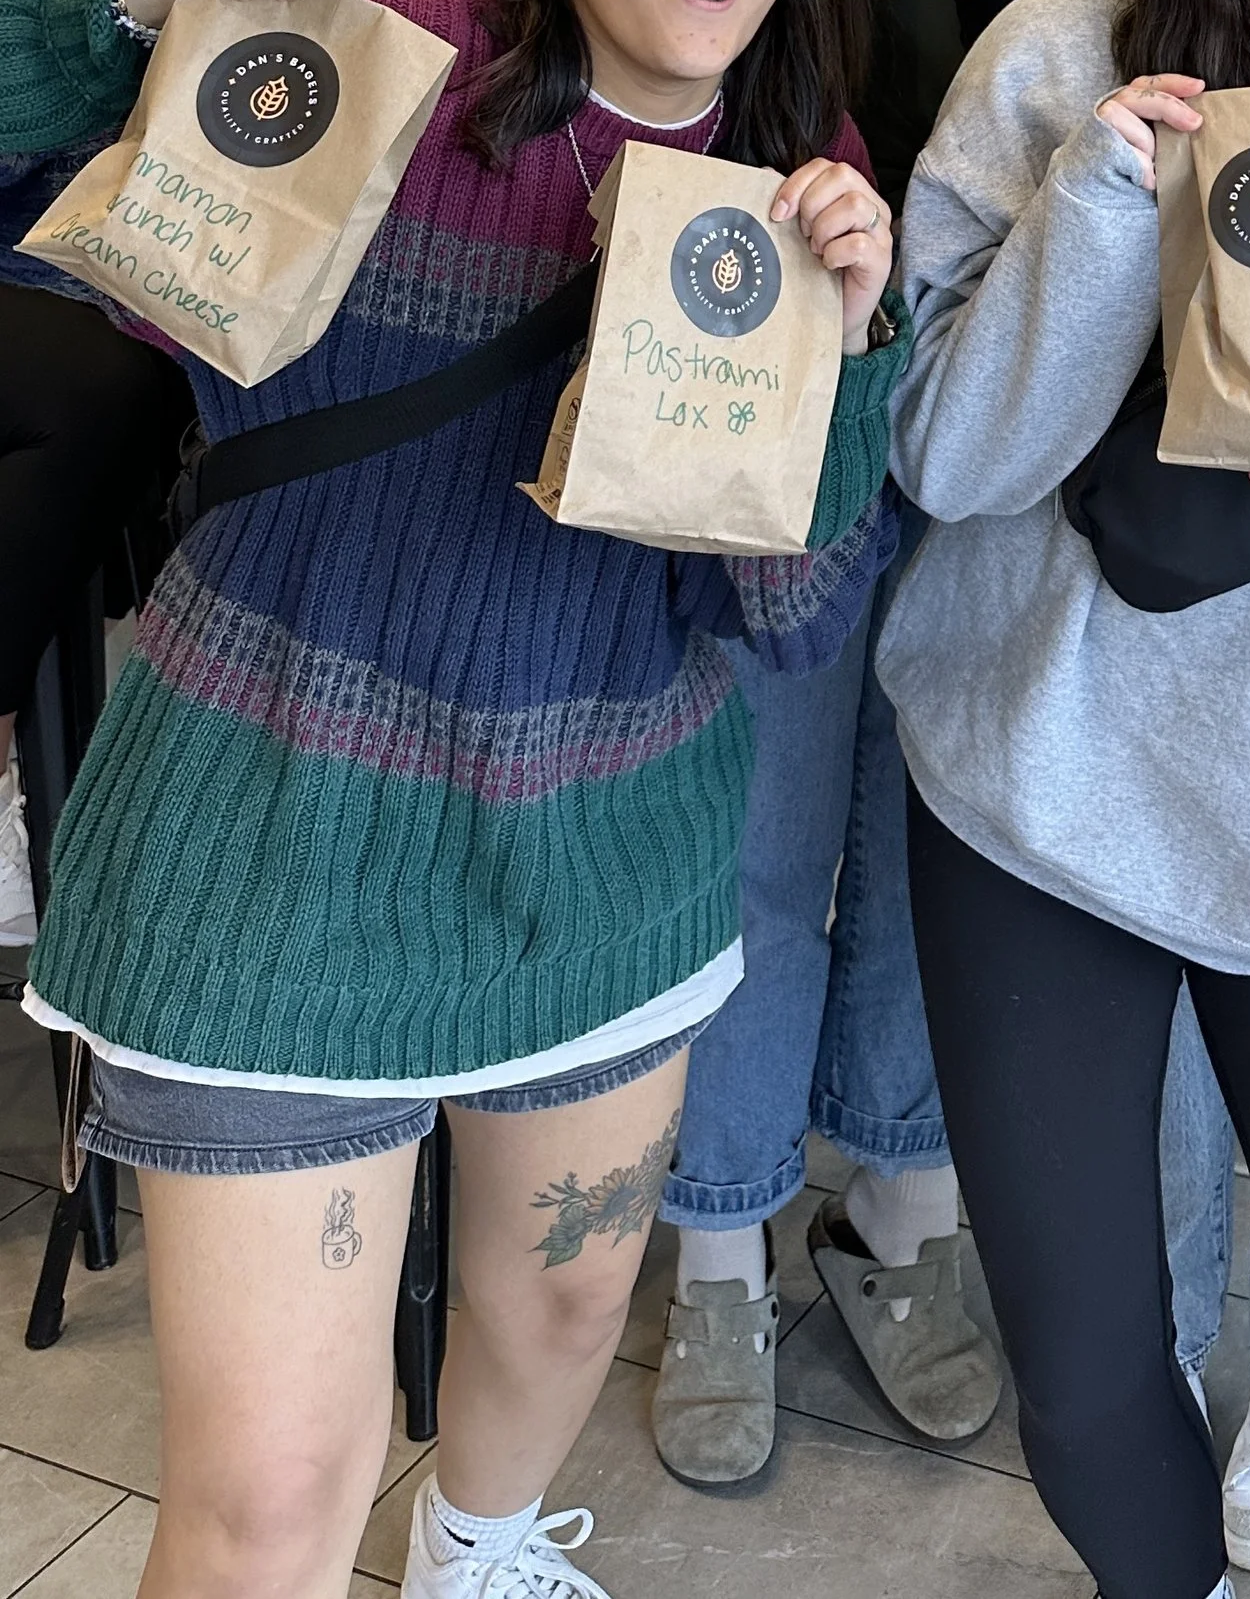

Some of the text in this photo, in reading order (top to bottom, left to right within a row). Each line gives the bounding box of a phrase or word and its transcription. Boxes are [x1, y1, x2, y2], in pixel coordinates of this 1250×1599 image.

[236, 53, 318, 105] DAN'S BAGELS
[220, 90, 243, 134] QUALITY
[254, 123, 305, 145] CRAFTED
[128, 151, 252, 234] nnamon
[694, 227, 763, 274] DAN'S BAGELS
[689, 270, 714, 310] QUALITY
[724, 291, 759, 315] CRAFTED
[622, 319, 780, 391] Pastrami
[656, 390, 709, 429] Lox
